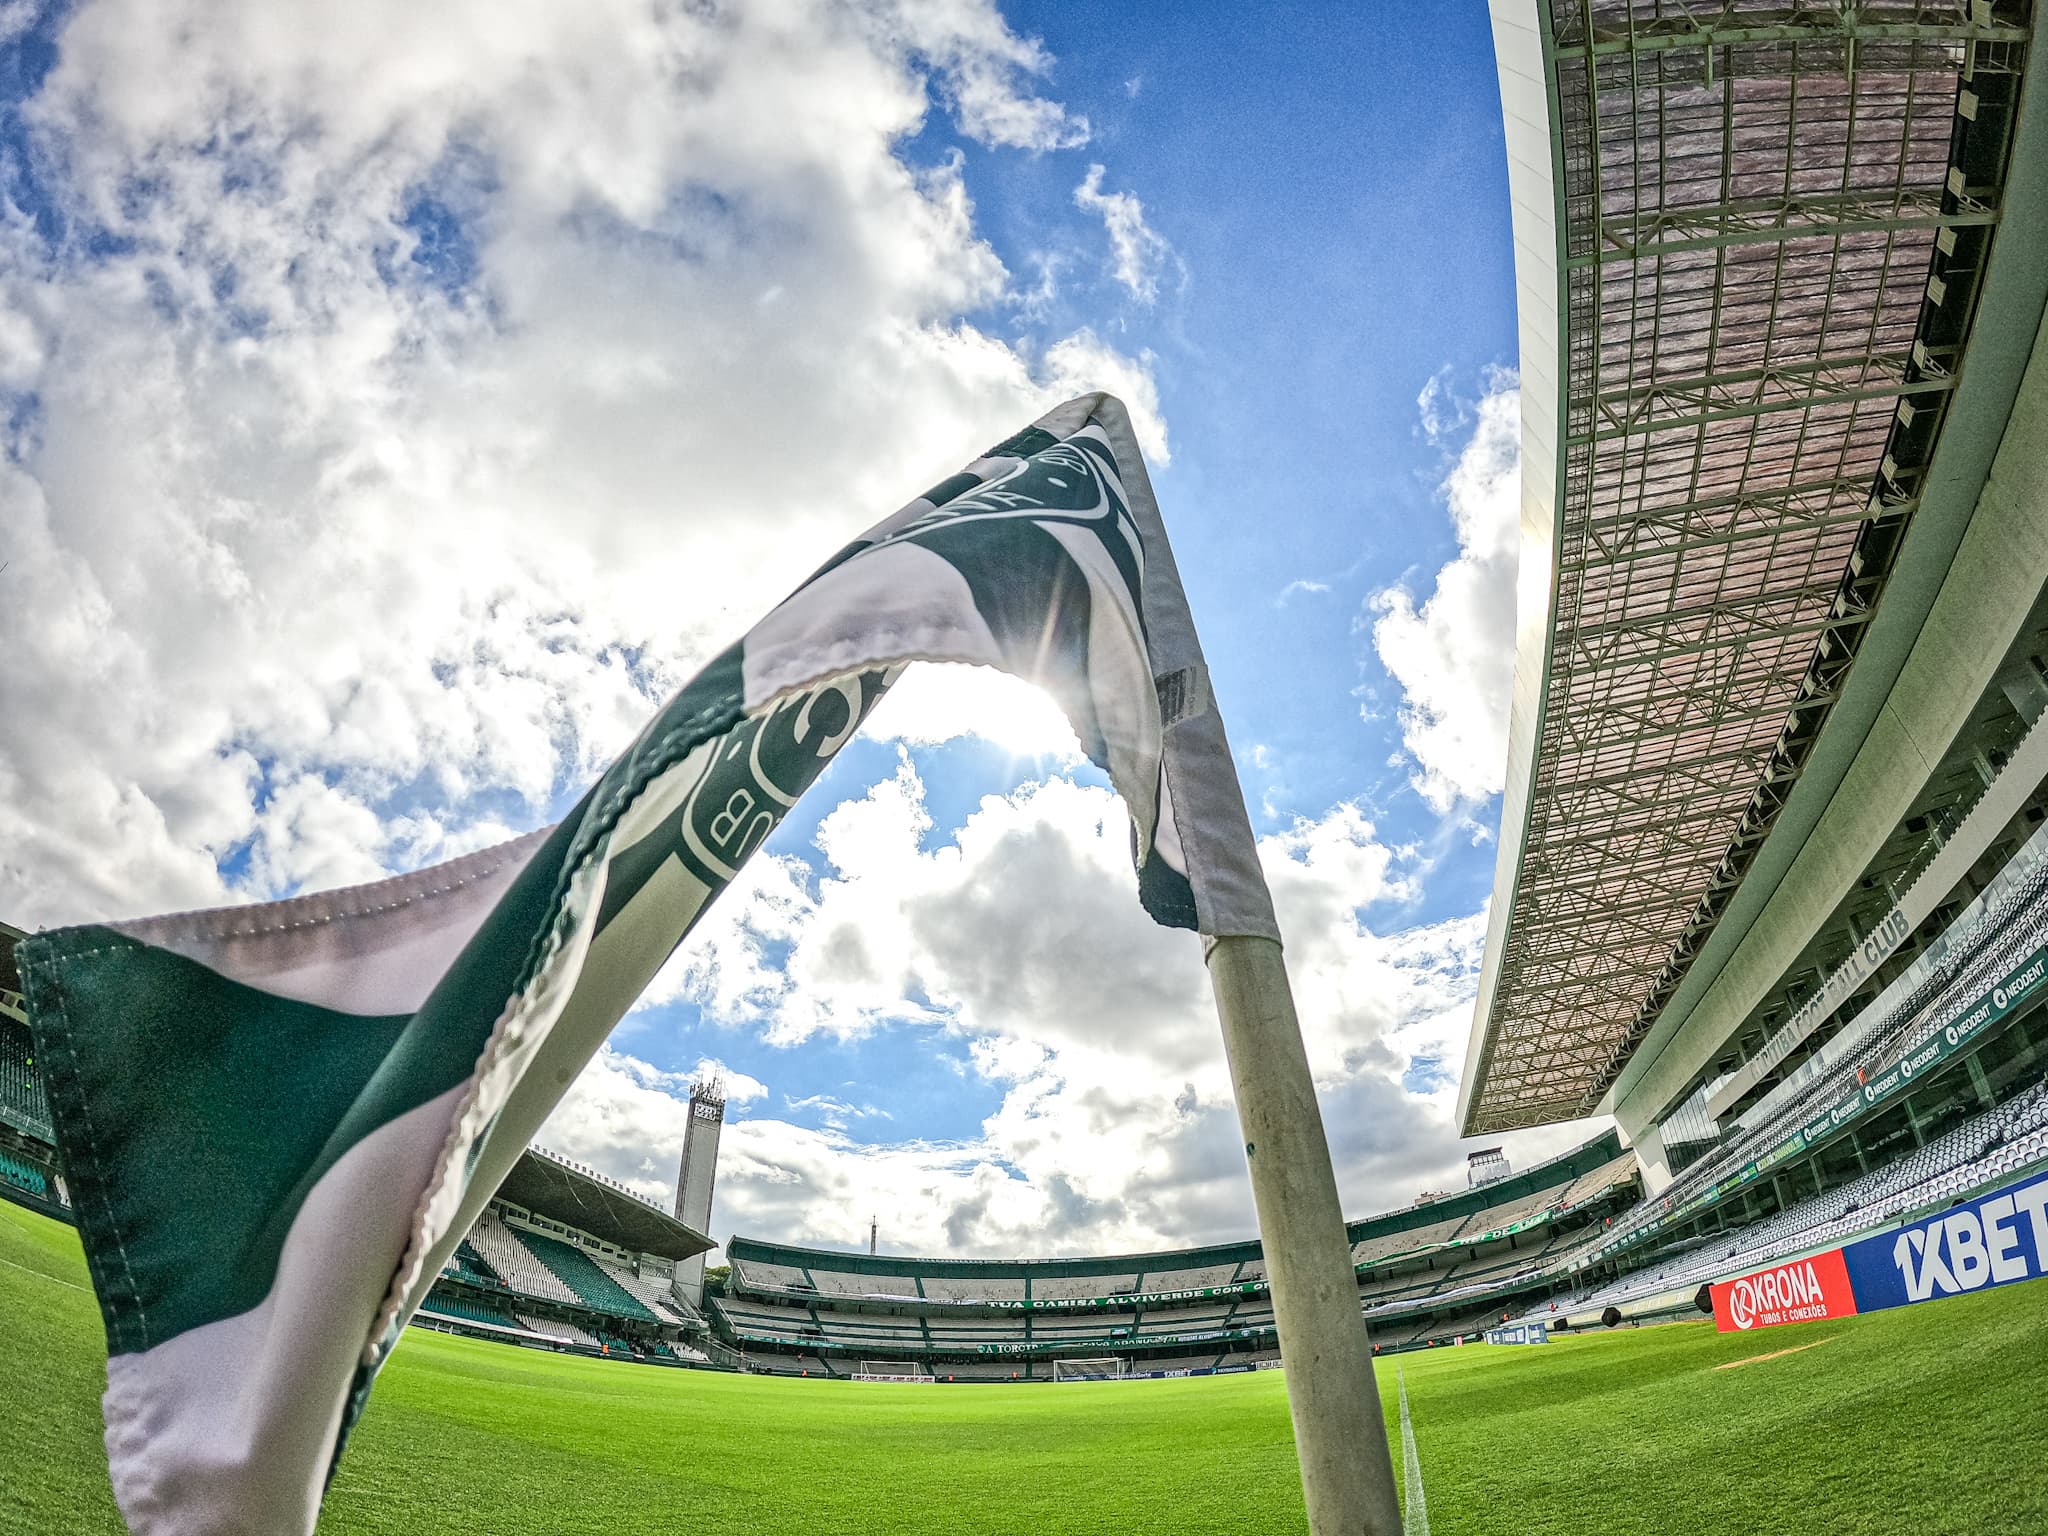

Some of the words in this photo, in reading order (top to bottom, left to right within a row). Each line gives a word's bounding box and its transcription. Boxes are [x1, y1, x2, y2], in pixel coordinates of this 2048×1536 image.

[1865, 910, 1909, 966] CLUB
[2006, 959, 2045, 999] NEODENT
[1956, 1003, 1991, 1037] NEODENT
[1910, 1042, 1940, 1071] NEODENT
[1873, 1071, 1900, 1096] NEODENT
[1838, 1097, 1861, 1119] NEODENT
[1810, 1119, 1830, 1137] NEODENT
[1893, 1178, 2048, 1302] 1XBET
[1033, 1299, 1097, 1307] CAMISA
[1105, 1291, 1204, 1304] ALVIVERDE
[1212, 1285, 1243, 1295] COM
[1753, 1261, 1824, 1312] KRONA
[1760, 1312, 1781, 1325] TUBOS
[1783, 1311, 1788, 1321] E
[1789, 1304, 1827, 1320] CONEXÕES
